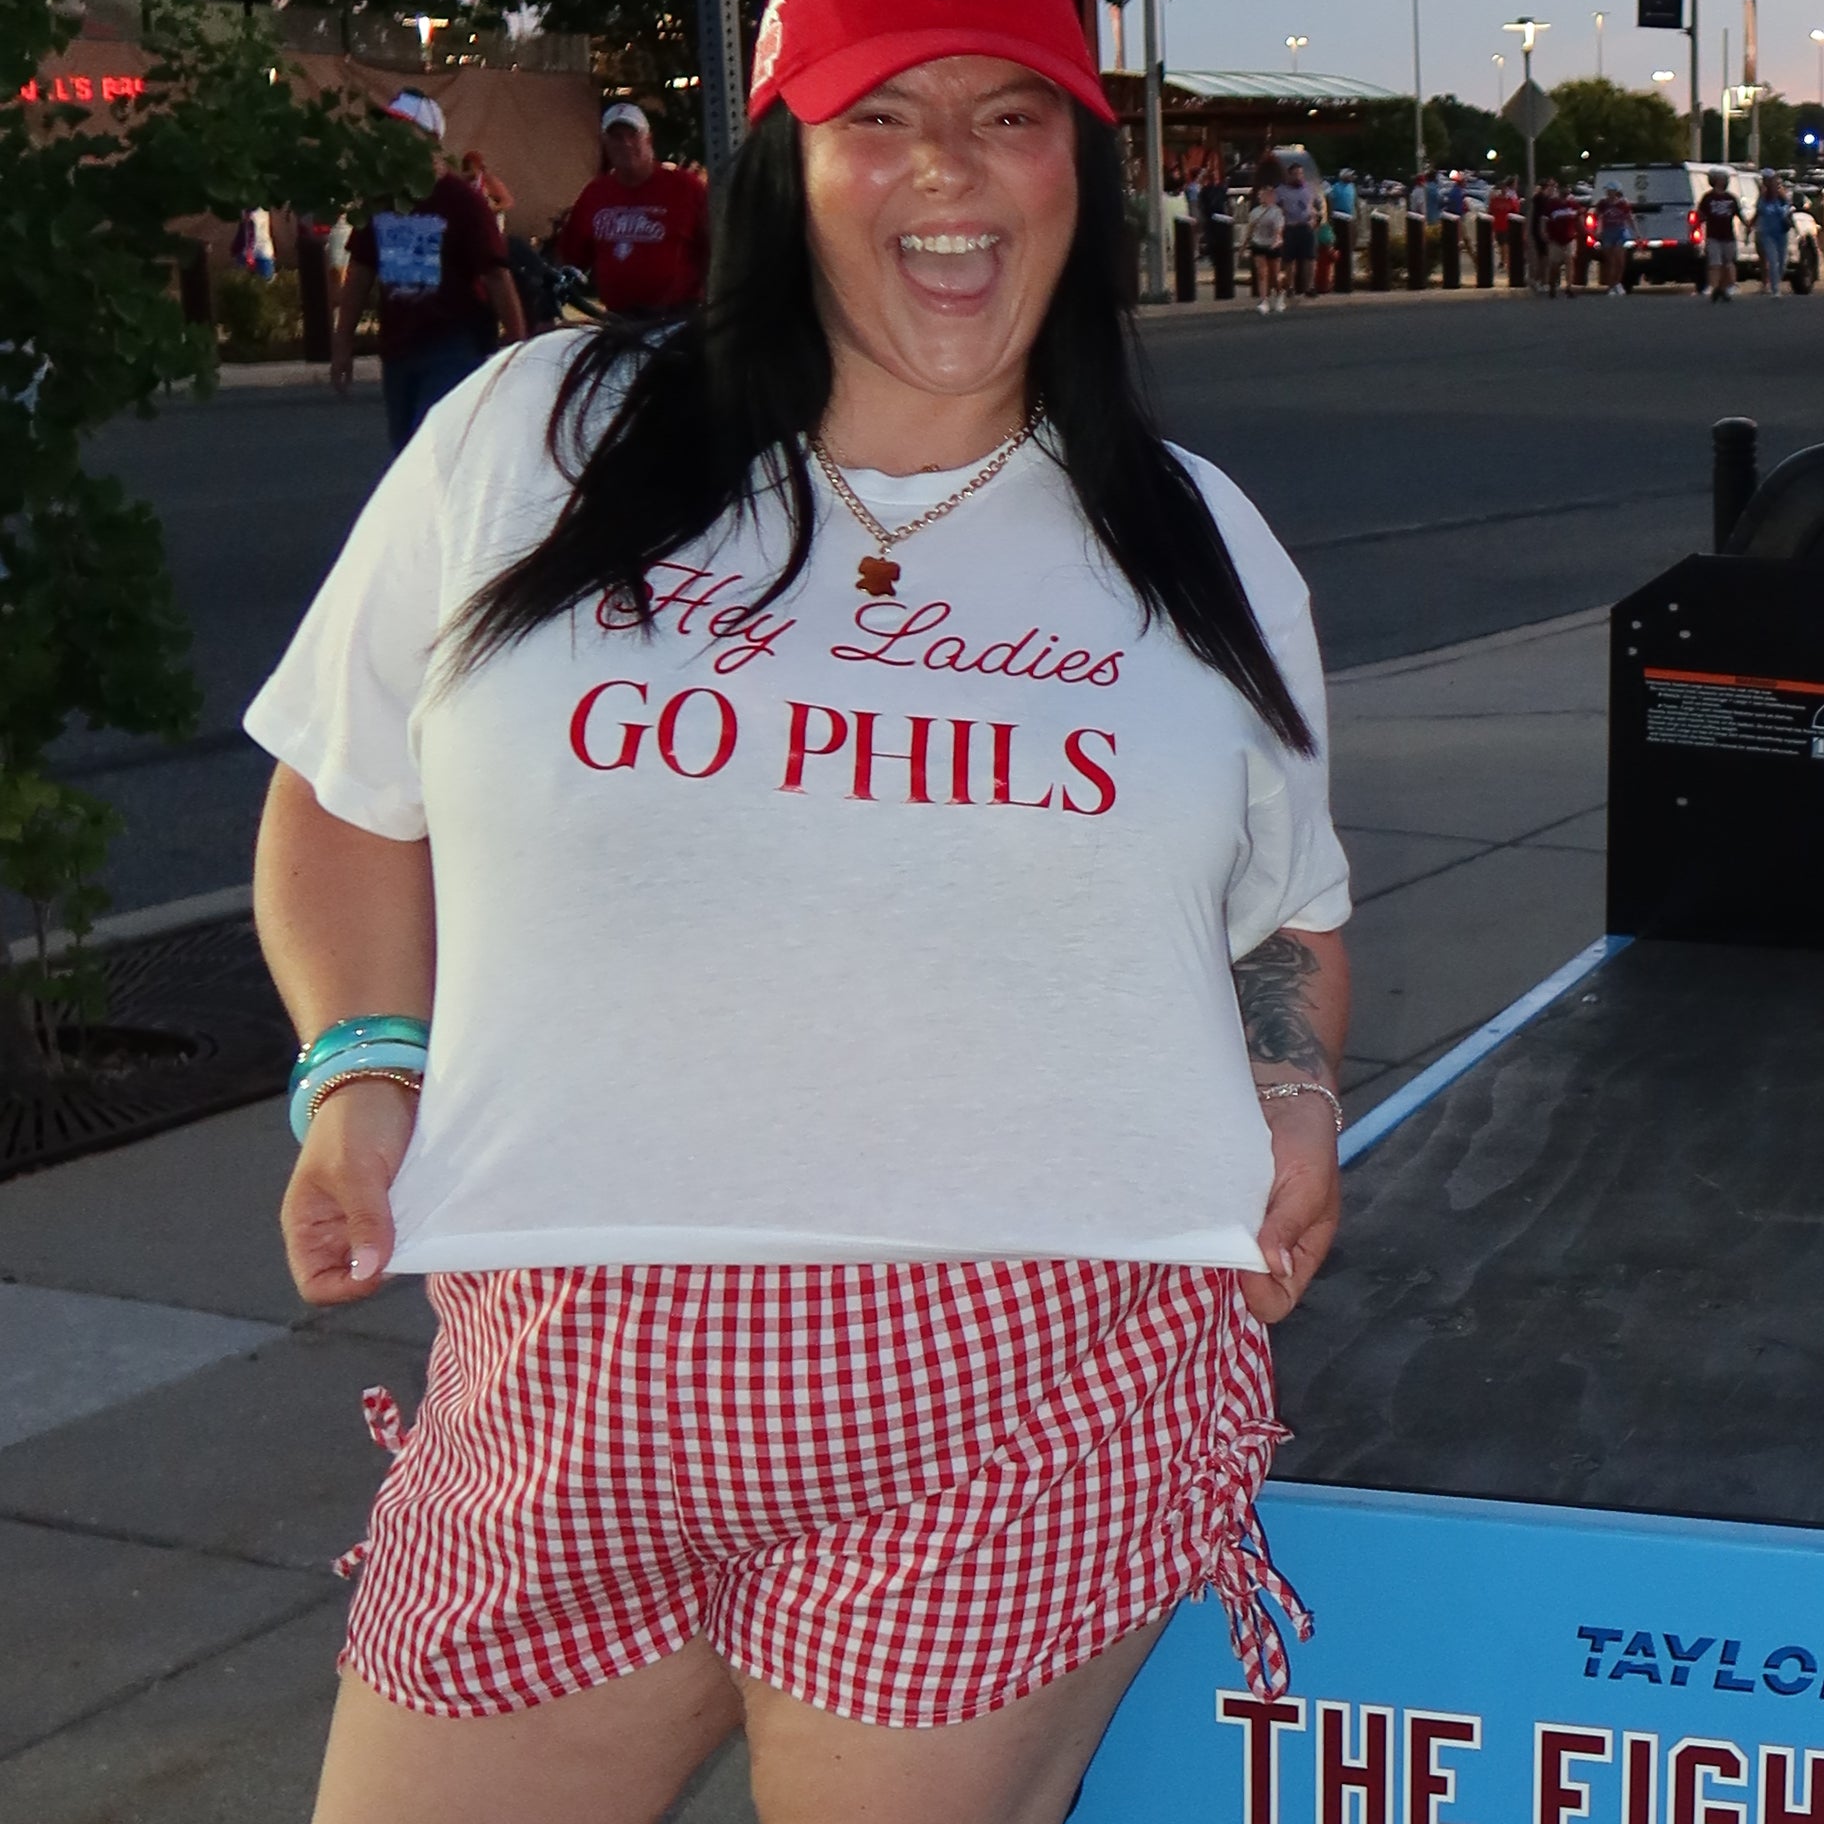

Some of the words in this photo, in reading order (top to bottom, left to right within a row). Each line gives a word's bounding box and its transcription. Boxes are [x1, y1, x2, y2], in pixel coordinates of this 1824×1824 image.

[595, 560, 796, 674] Hey
[831, 601, 1125, 686] Ladies
[569, 679, 739, 778] GO
[774, 699, 1117, 816] PHILS
